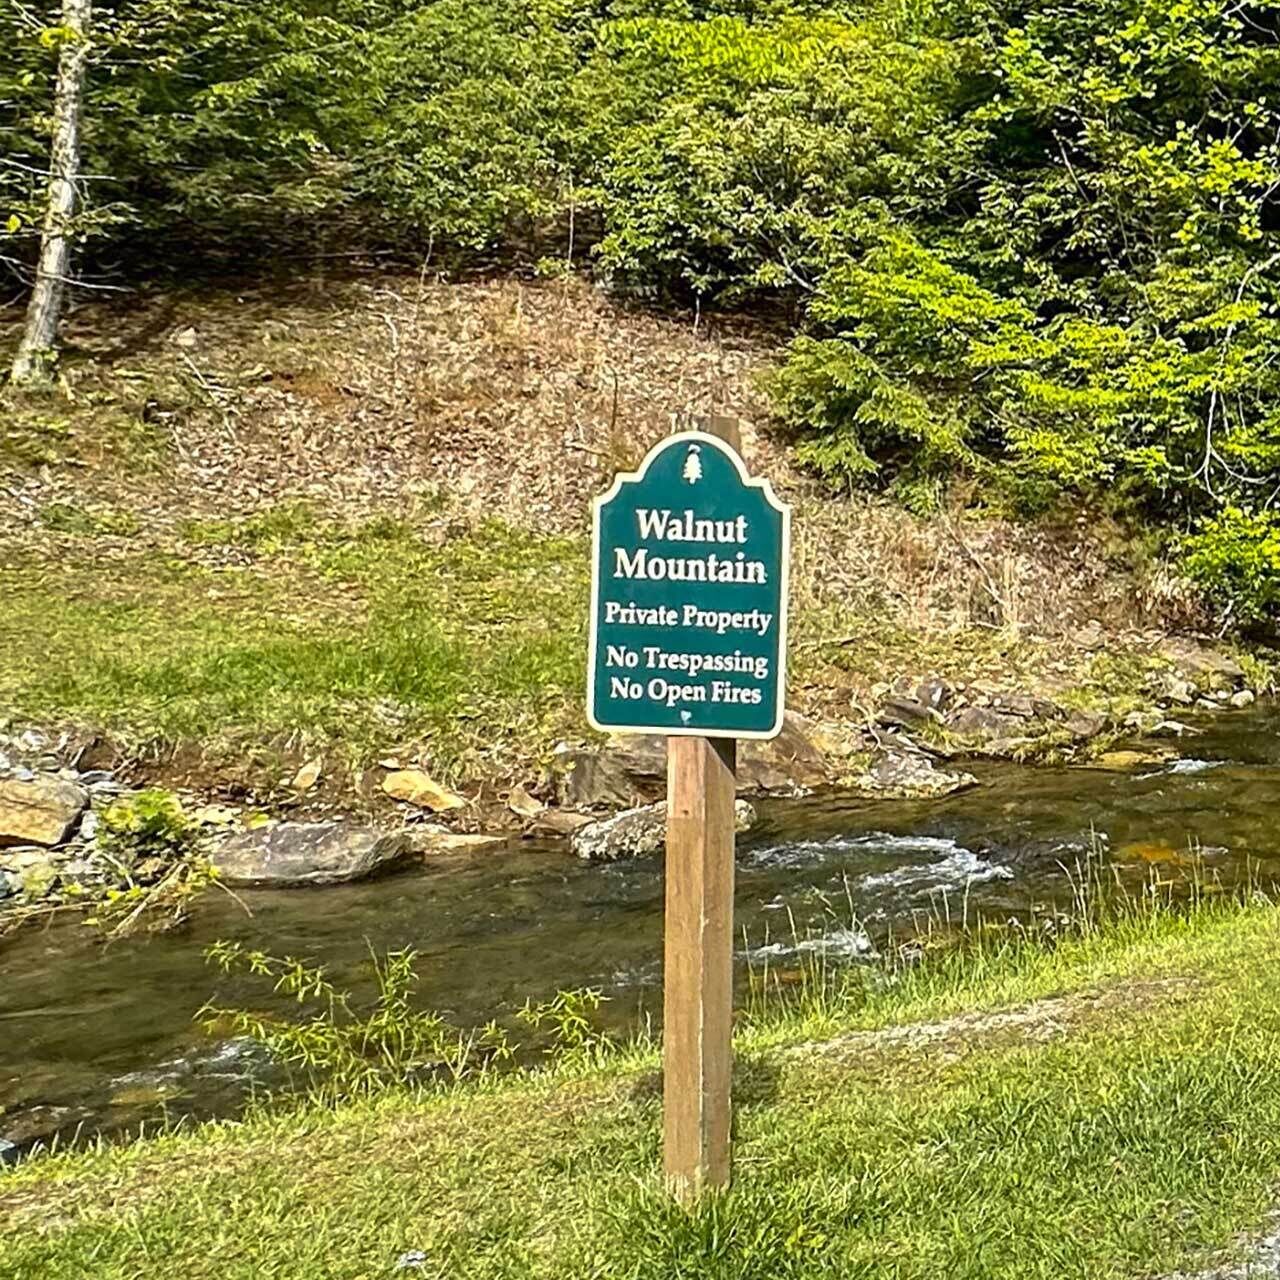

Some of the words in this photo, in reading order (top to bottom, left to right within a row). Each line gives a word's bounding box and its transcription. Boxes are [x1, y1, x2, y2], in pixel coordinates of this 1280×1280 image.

[636, 509, 748, 543] Walnut
[613, 548, 768, 583] Mountain
[605, 602, 678, 626] Private
[683, 605, 771, 635] Property
[606, 646, 638, 668] No
[643, 647, 768, 679] Trespassing
[611, 677, 645, 699] No
[648, 679, 706, 706] Open
[711, 682, 761, 704] Fires
